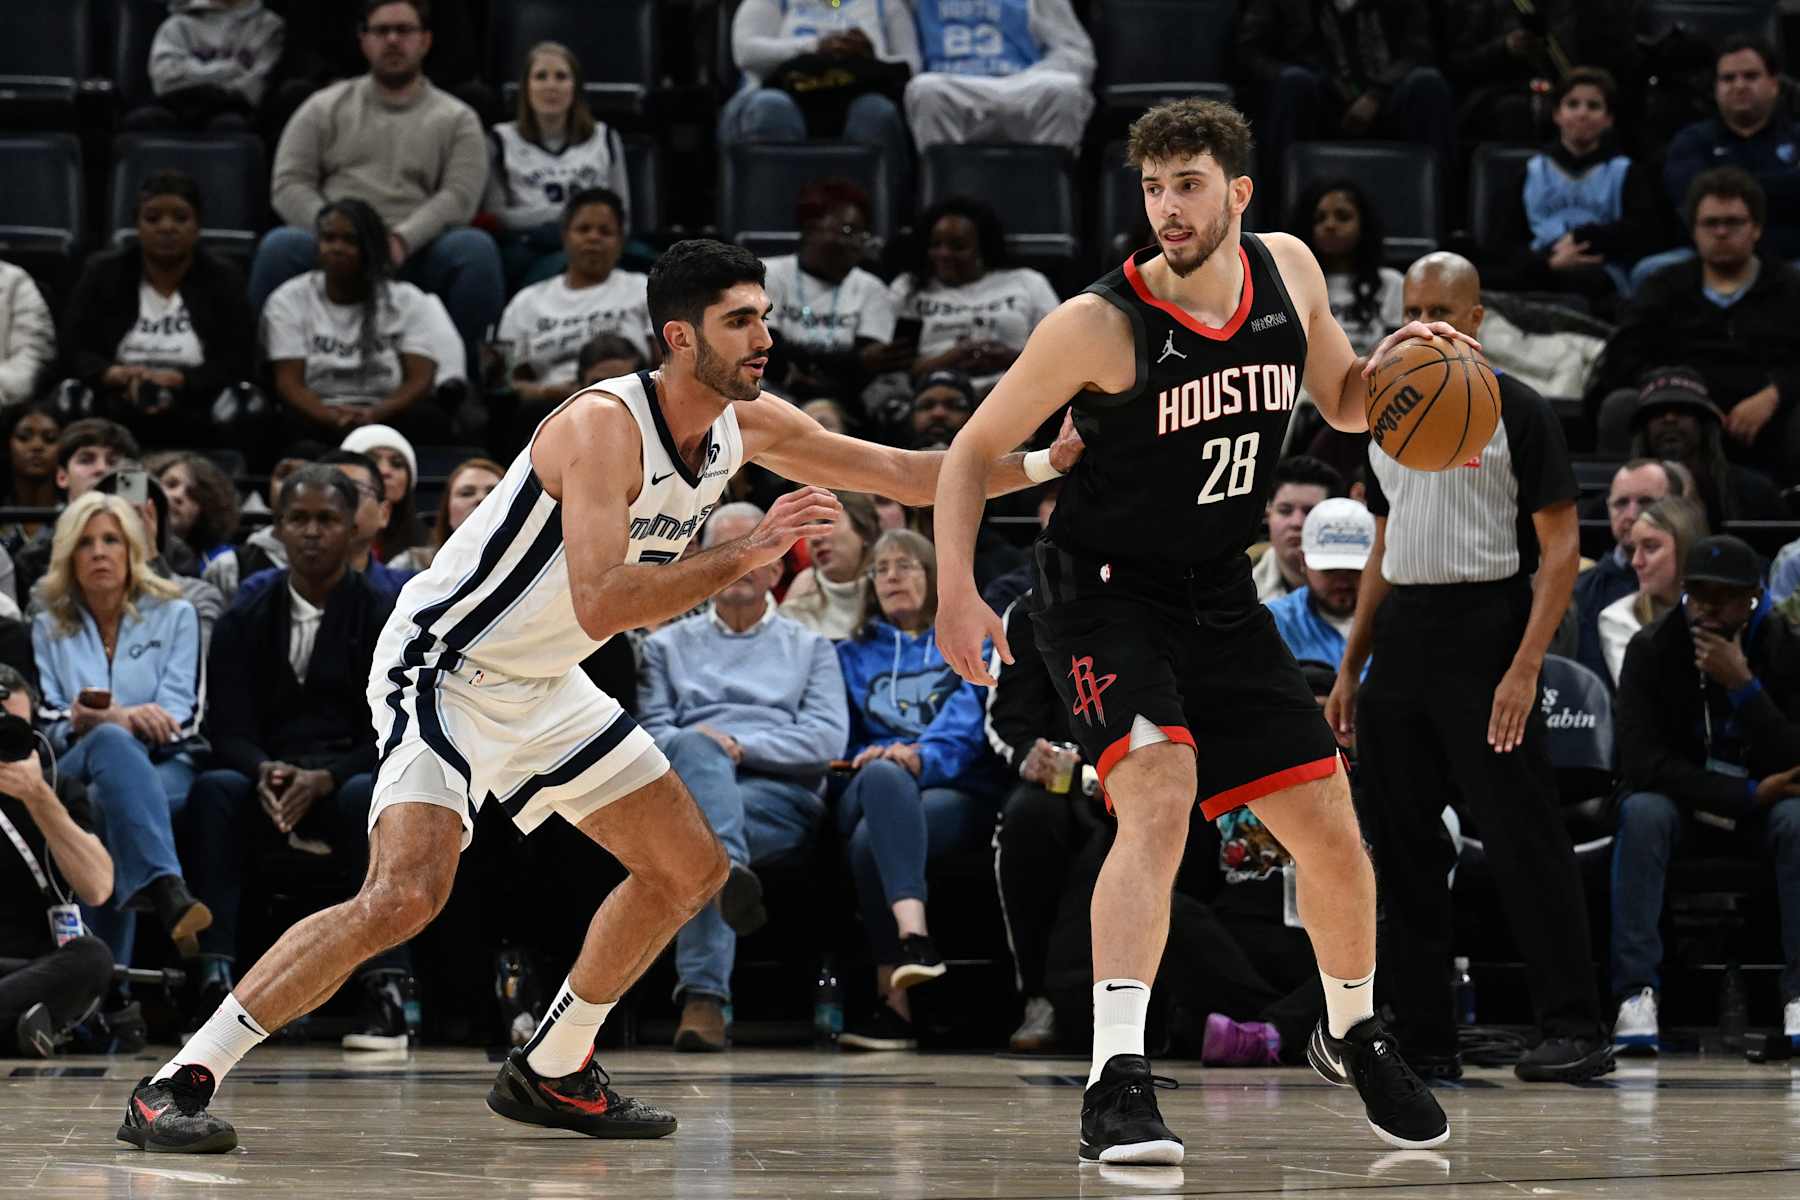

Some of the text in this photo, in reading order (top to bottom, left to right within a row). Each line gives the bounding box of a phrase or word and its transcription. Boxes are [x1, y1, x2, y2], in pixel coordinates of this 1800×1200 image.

[1158, 364, 1297, 436] HOUSTON
[1197, 431, 1260, 505] 28
[1541, 706, 1596, 729] abin
